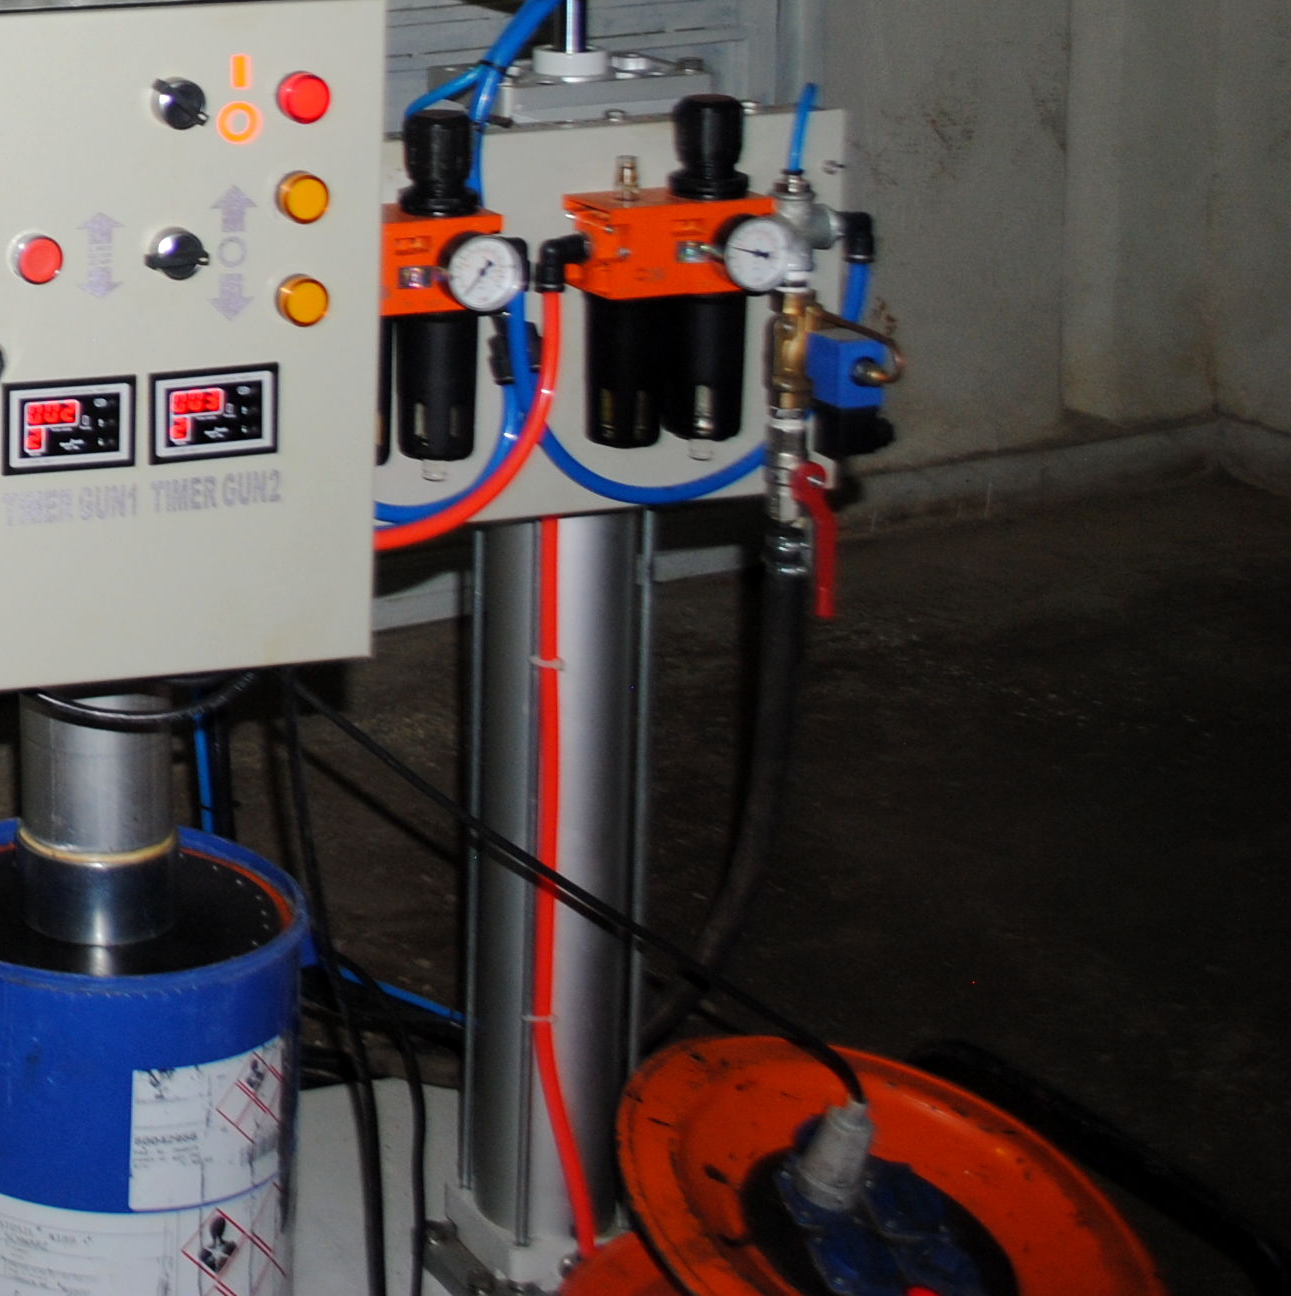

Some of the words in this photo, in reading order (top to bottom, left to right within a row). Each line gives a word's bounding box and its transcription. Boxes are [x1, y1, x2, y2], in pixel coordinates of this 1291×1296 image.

[77, 481, 138, 521] GUN1
[150, 475, 218, 515] TIMER
[222, 469, 283, 508] GUN2
